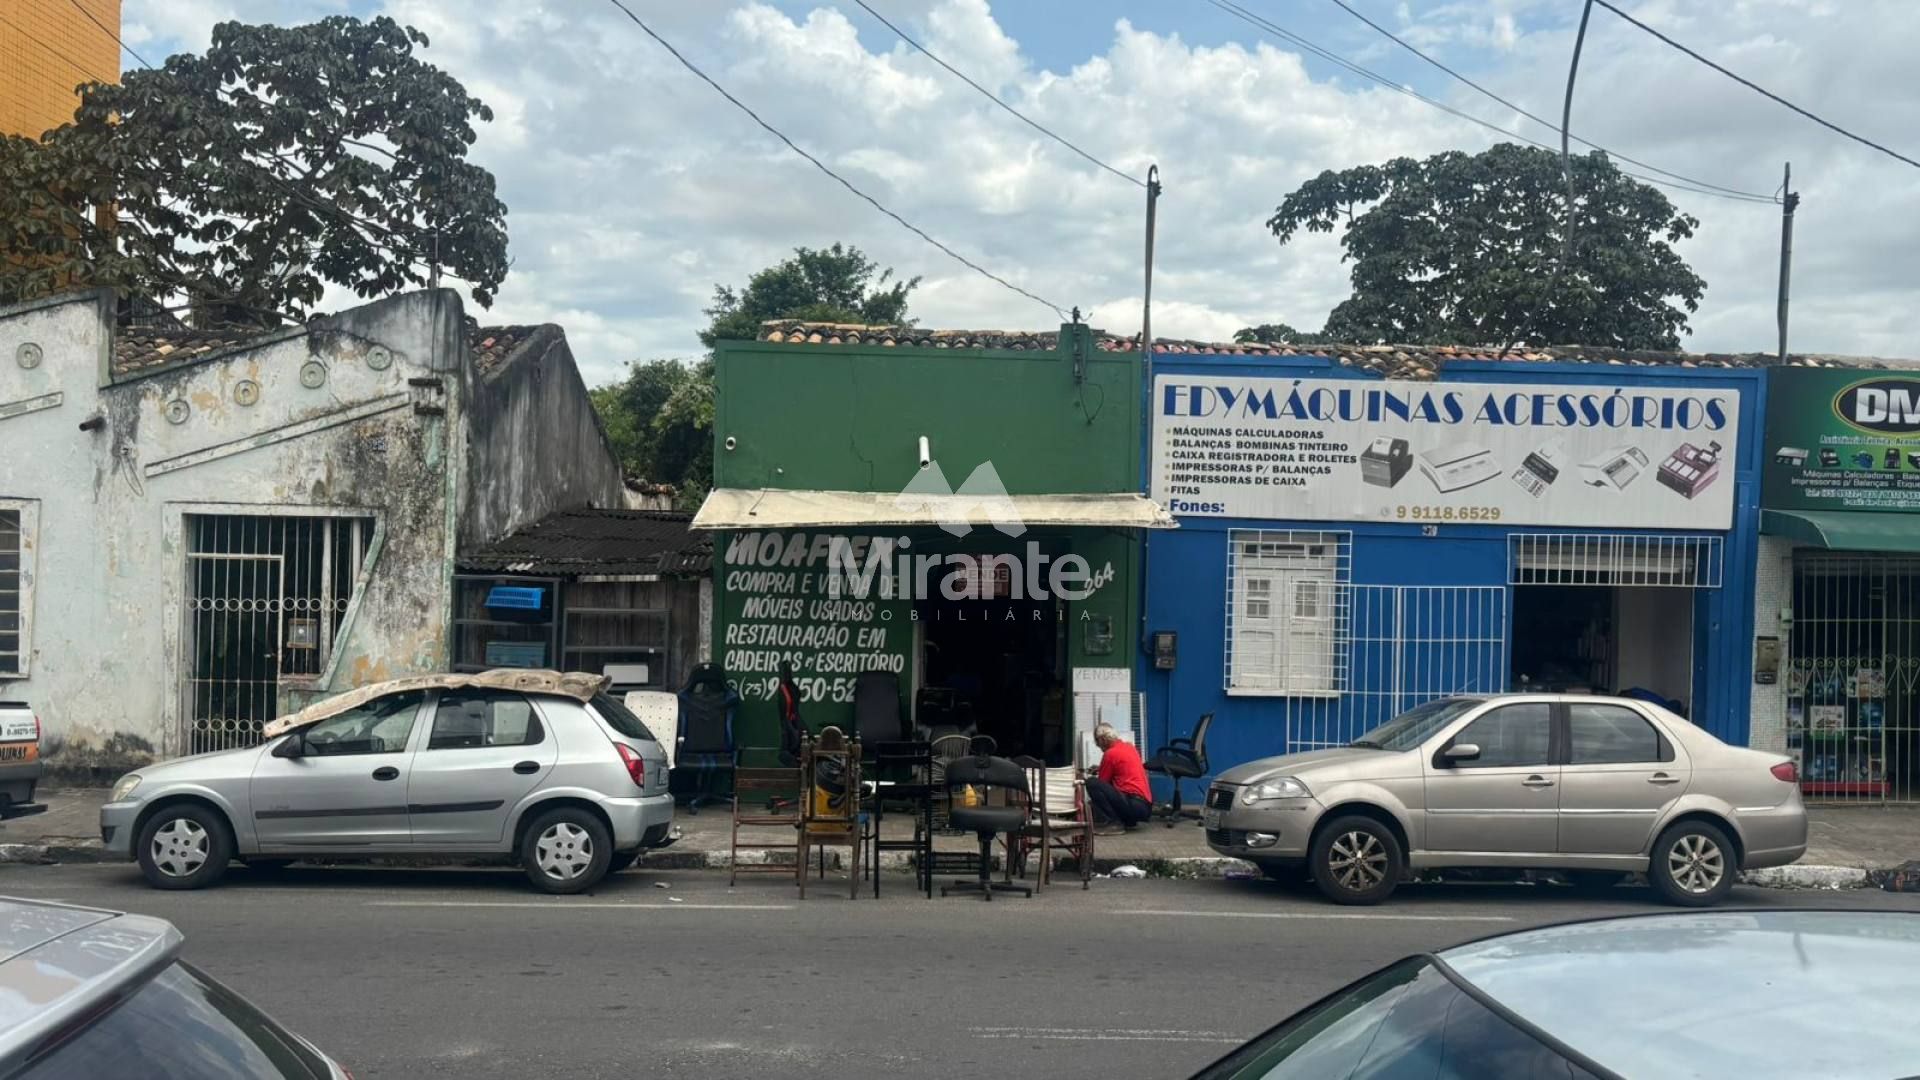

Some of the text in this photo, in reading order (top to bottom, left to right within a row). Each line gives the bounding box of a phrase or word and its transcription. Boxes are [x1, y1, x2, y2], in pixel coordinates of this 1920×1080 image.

[1163, 380, 1726, 430] EDYMÁQUINAS ACESSÓRIOS
[1172, 425, 1324, 439] MÁQUINAS CALCULADORAS
[1172, 440, 1348, 451] BALANÇAS BOMBINAS TINTEIRO
[1172, 451, 1357, 463] CAIXA REGISTRADORA E ROLETES
[1171, 463, 1331, 476] IMPRESSORAS P/ BALANÇAS
[1171, 474, 1306, 486] IMPRESSORAS DE CAIXA
[1170, 486, 1200, 495] FITAS
[1170, 499, 1225, 513] Fones:
[1396, 505, 1500, 520] 9 9118.6529
[724, 532, 898, 570] MOAFLEX
[726, 571, 899, 597] COMPRA E VENDA DE
[1084, 561, 1115, 598] 264
[742, 594, 875, 622] MÓVEIS USADOS
[857, 627, 887, 648] EM
